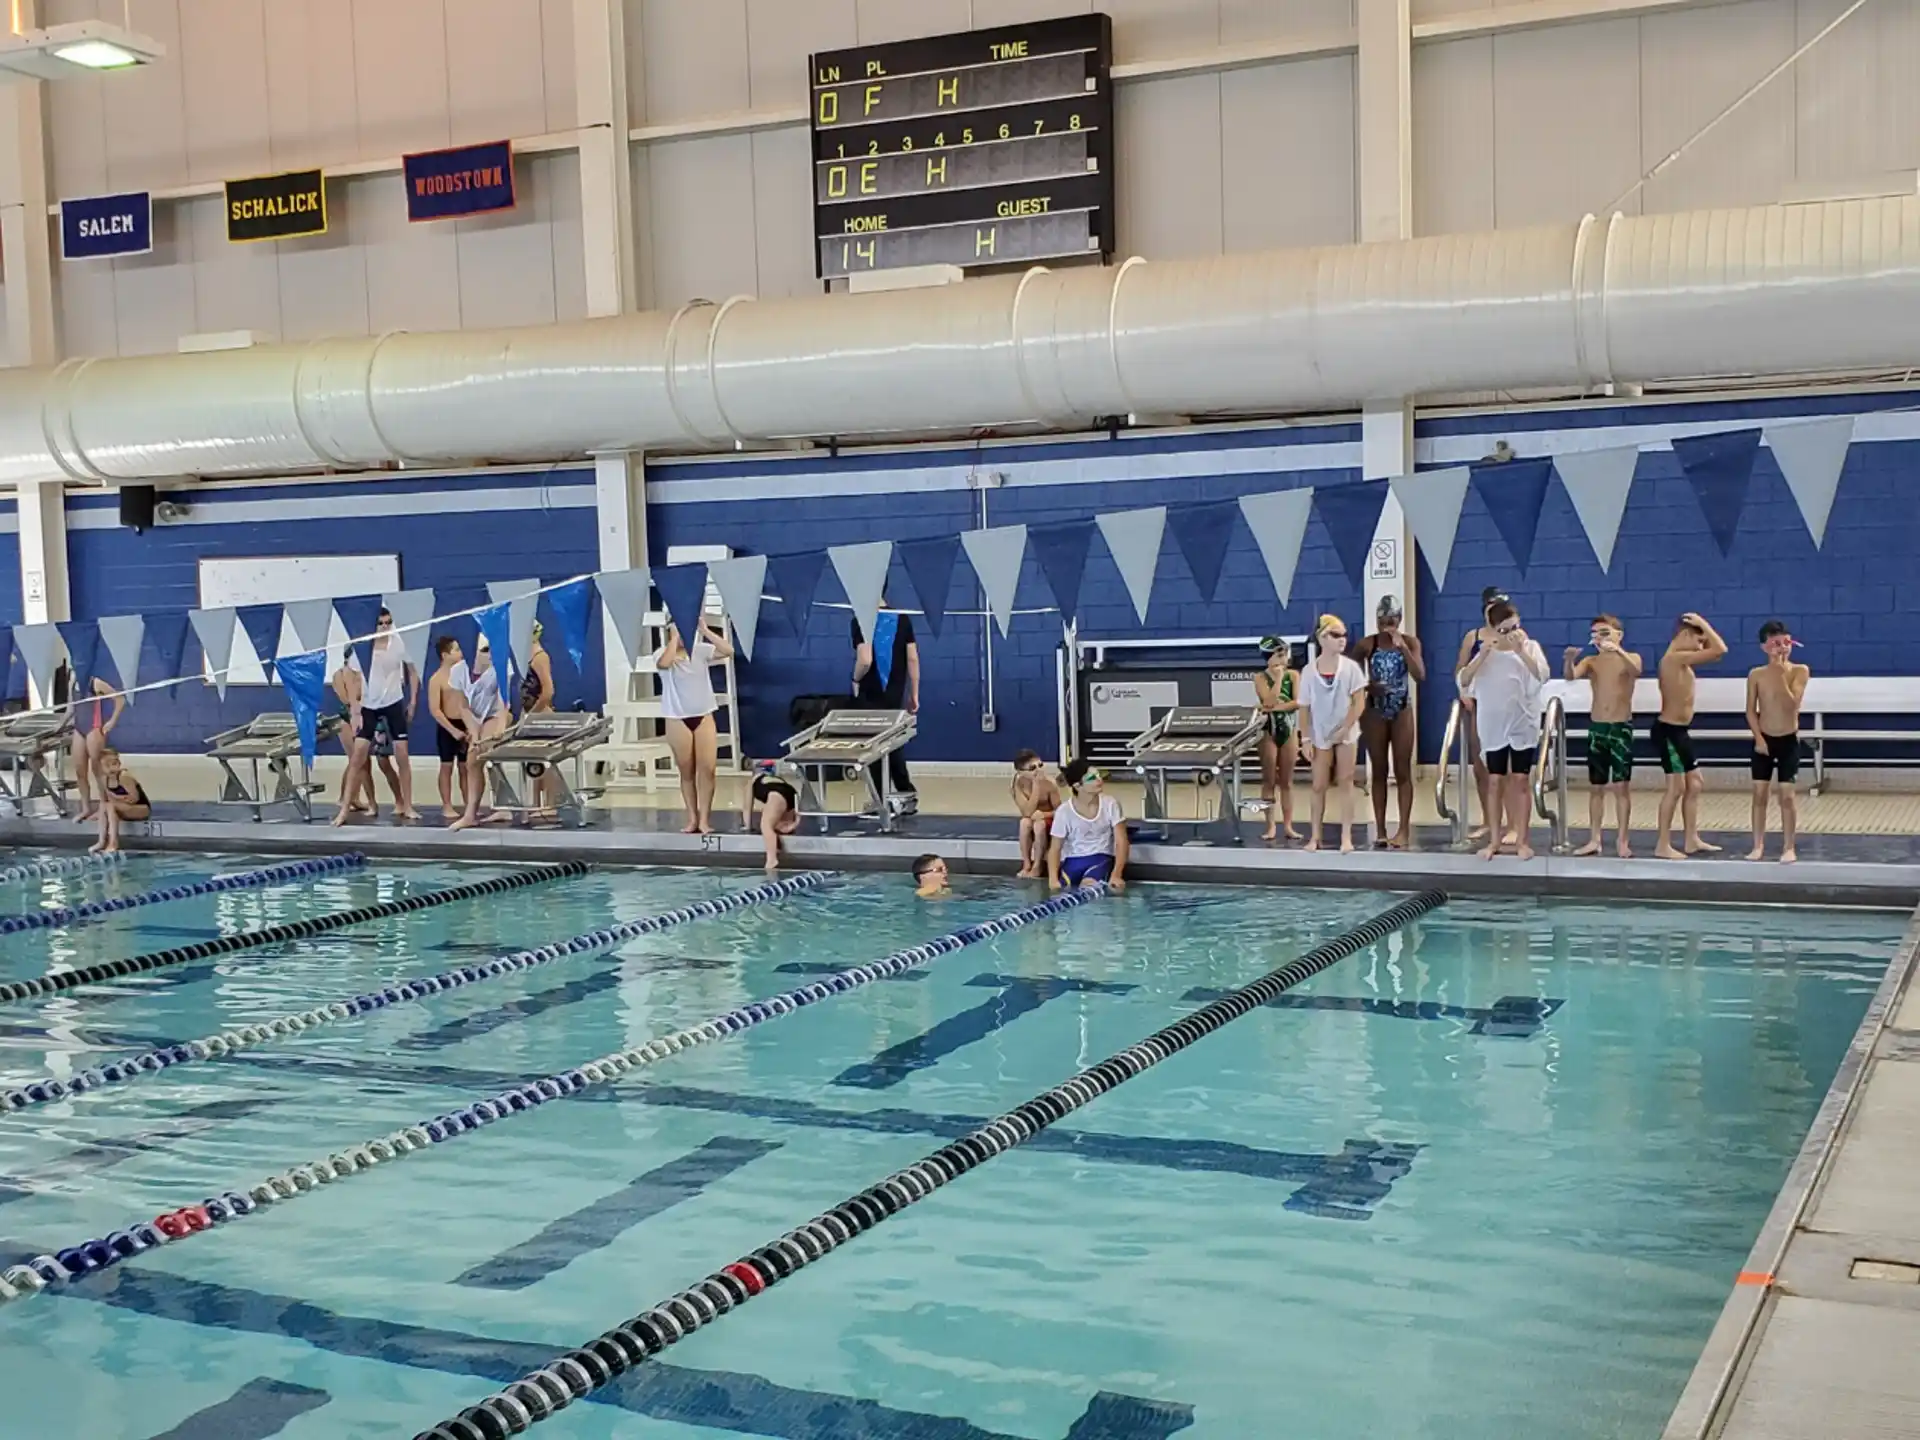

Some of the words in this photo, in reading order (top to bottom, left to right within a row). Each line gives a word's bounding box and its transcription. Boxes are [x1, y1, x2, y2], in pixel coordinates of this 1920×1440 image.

[820, 67, 840, 82] LN
[866, 60, 886, 76] PL
[989, 41, 1028, 59] TIME
[865, 86, 882, 116] F
[938, 77, 958, 106] H
[837, 144, 845, 158] 1
[869, 141, 878, 156] 2
[902, 137, 913, 151] 3
[934, 133, 944, 147] 4
[963, 129, 973, 144] 5
[999, 124, 1010, 139] 6
[1034, 120, 1044, 136] 7
[1070, 115, 1080, 130] 8
[415, 166, 503, 196] WOODSTOWN
[926, 157, 946, 186] H
[232, 192, 318, 220] SCHALICK
[844, 214, 888, 233] HOME
[997, 197, 1051, 217] GUEST
[79, 214, 134, 237] SALEM
[975, 227, 996, 257] H
